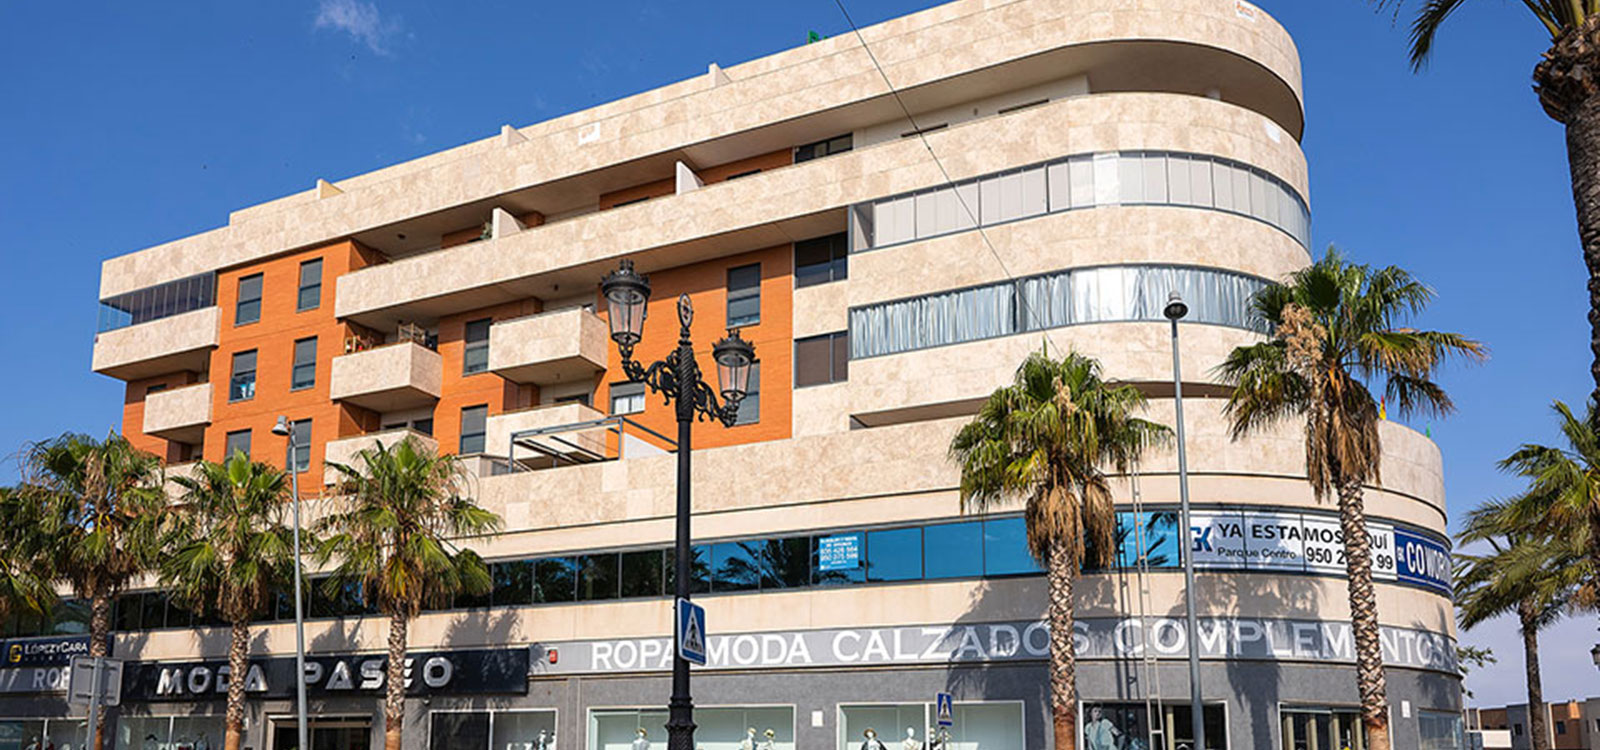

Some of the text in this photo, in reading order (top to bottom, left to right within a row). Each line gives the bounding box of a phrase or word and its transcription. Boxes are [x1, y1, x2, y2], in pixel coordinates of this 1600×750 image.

[1218, 523, 1388, 550] YA ESTAMOS QUÍ
[1217, 546, 1297, 560] Parque Centro
[1306, 547, 1332, 565] 950
[1376, 555, 1393, 570] 99
[705, 633, 812, 666] MODA
[832, 621, 1091, 662] CALZADOS
[1114, 618, 1446, 667] COMPLEMNTOS
[32, 666, 70, 690] ROP
[156, 664, 269, 695] MODA
